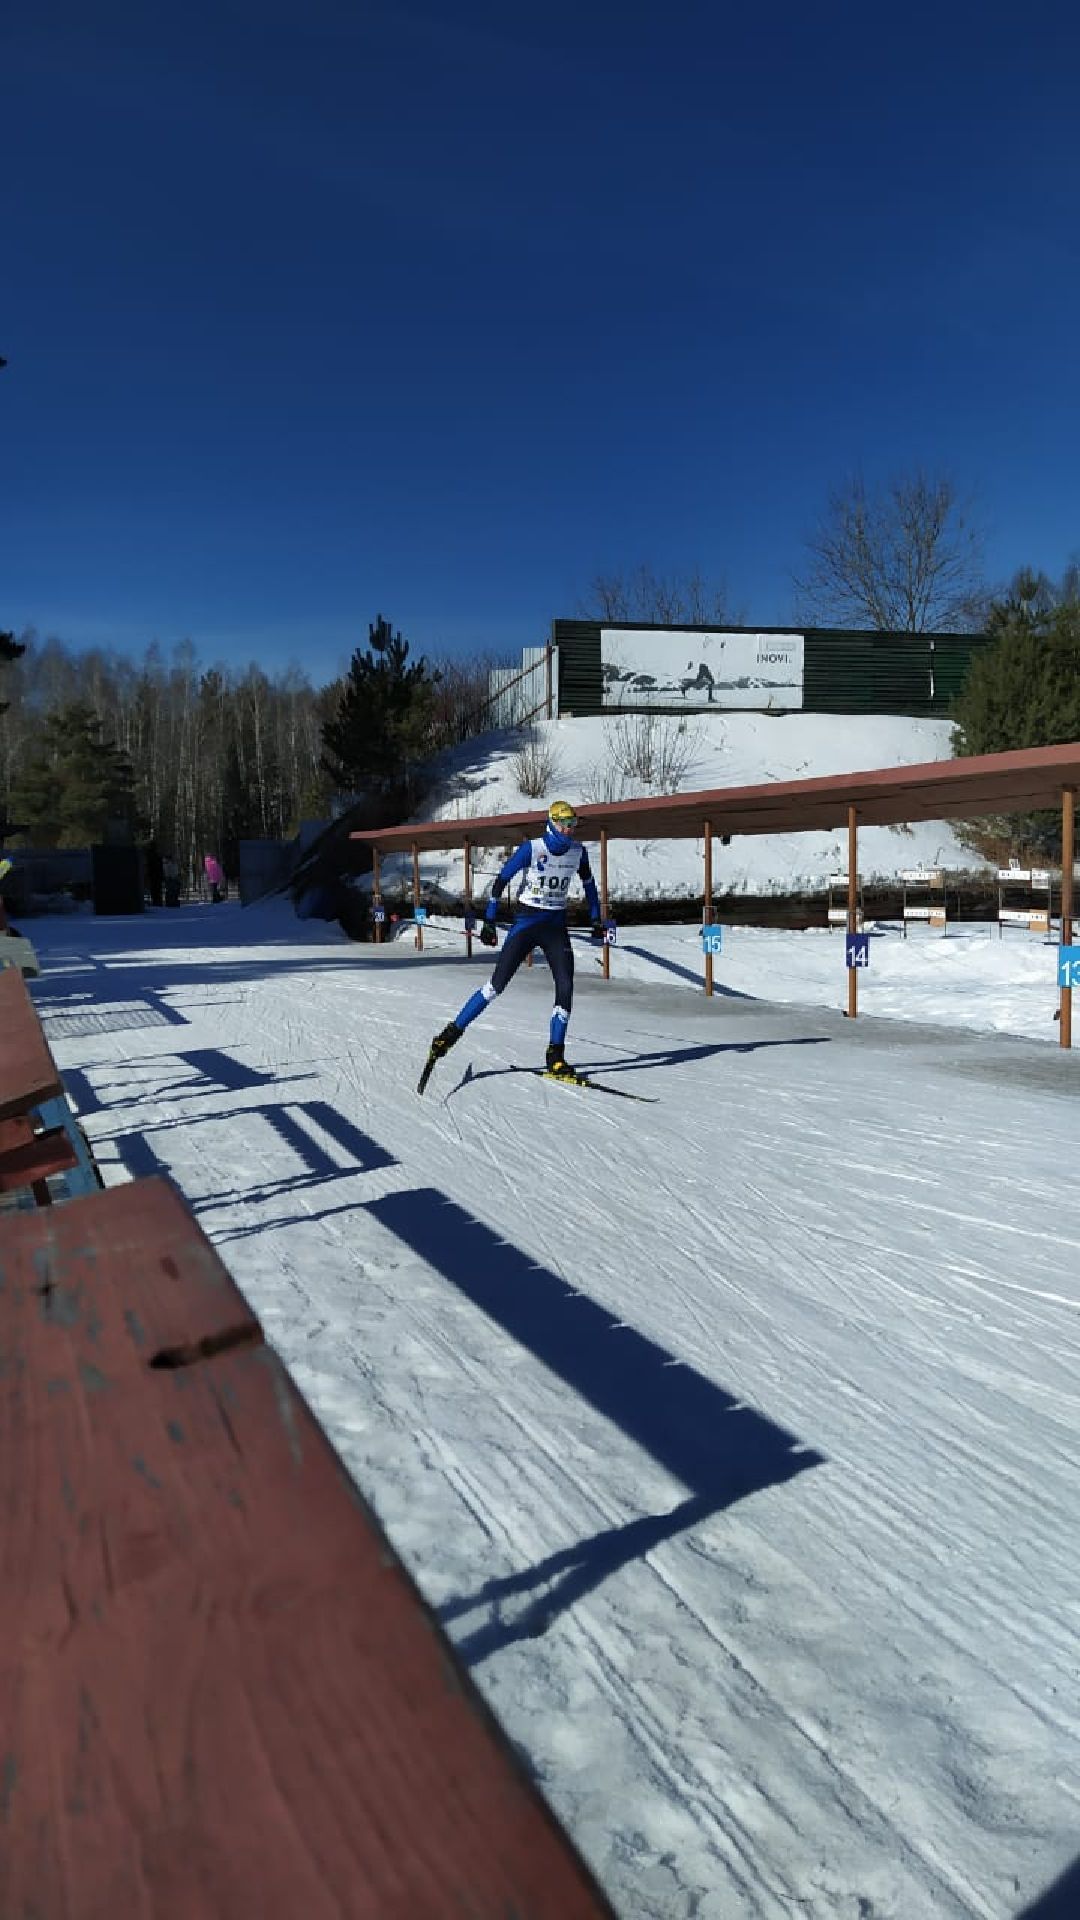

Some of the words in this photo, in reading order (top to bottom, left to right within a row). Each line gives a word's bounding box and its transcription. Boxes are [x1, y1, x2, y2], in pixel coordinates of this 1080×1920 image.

[704, 935, 721, 952] 15
[848, 945, 868, 967] 14
[1061, 960, 1080, 986] 13
